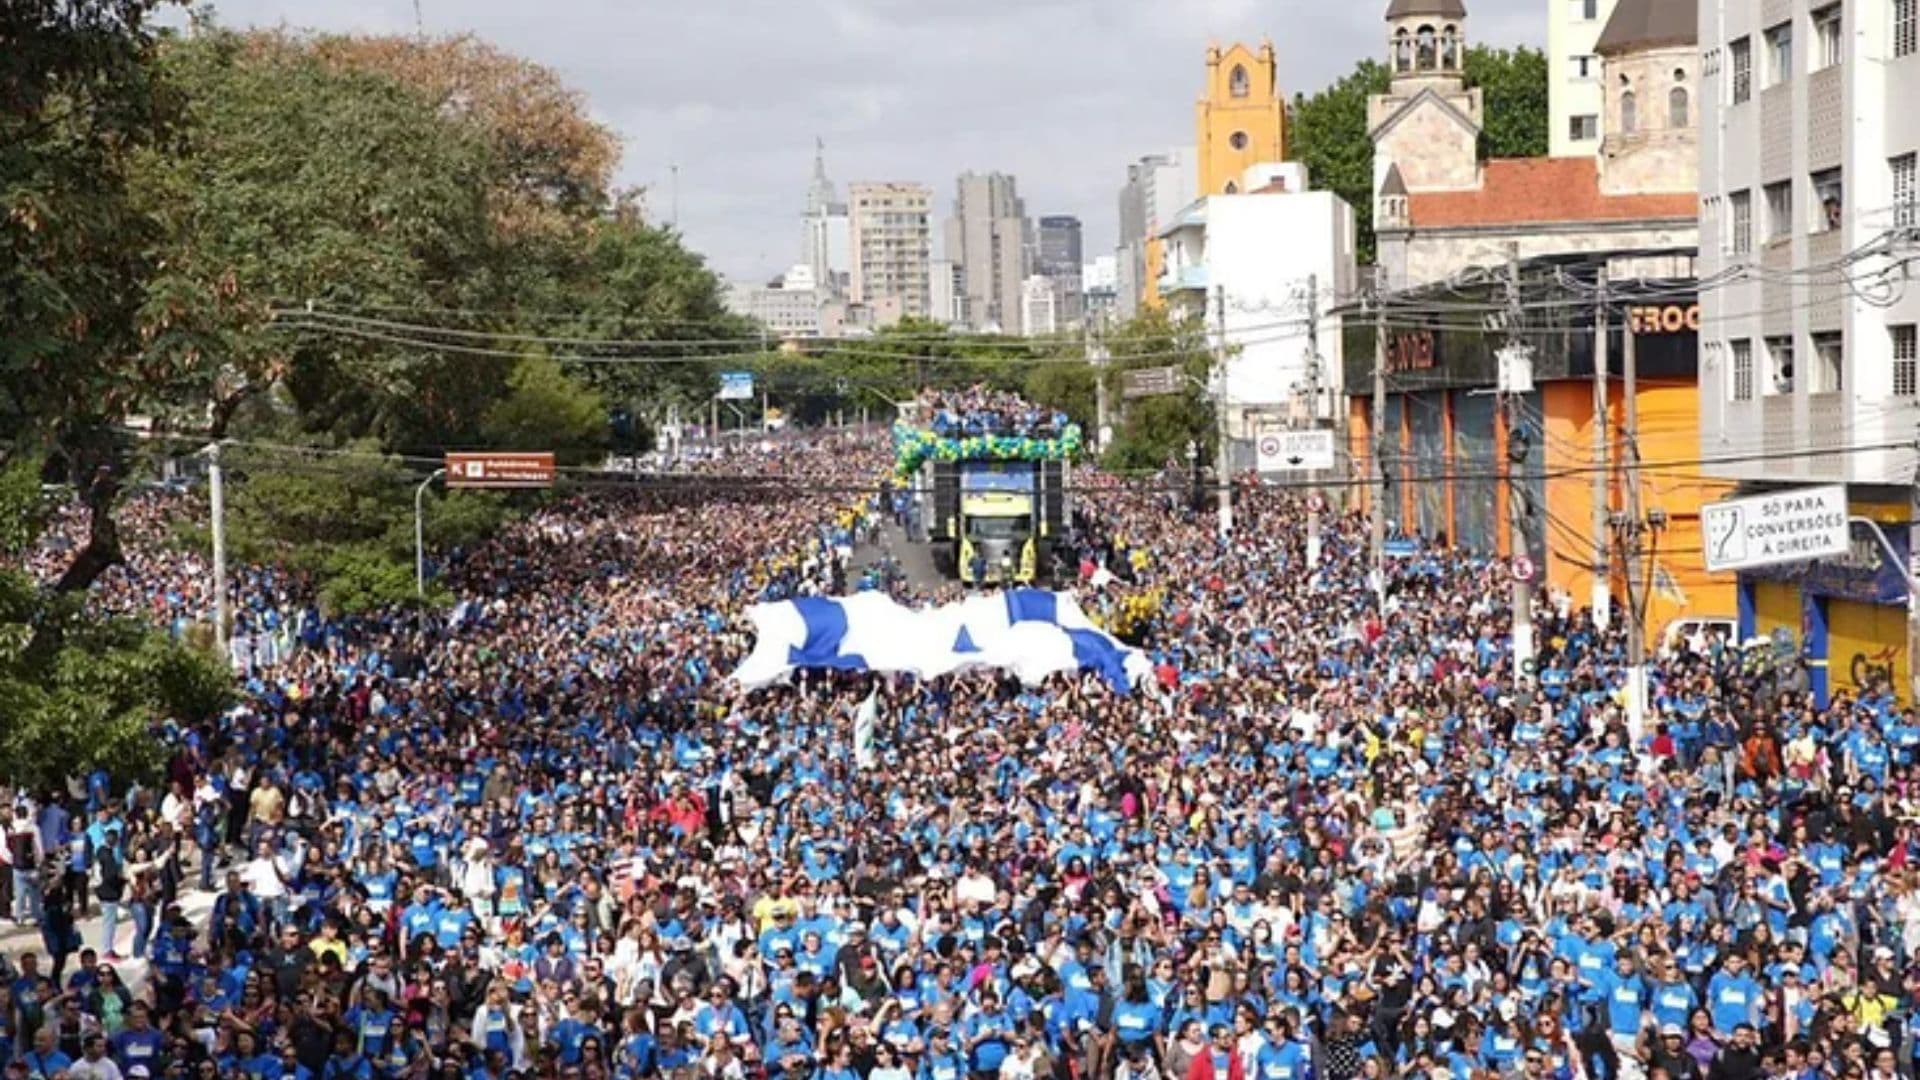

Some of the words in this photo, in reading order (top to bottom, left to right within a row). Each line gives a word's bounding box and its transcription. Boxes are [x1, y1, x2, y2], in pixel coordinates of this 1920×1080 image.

[1761, 498, 1781, 517] SÓ
[1785, 497, 1824, 514] PARA
[1747, 513, 1842, 538] CONVERSÕES
[1777, 534, 1831, 553] DIREITA
